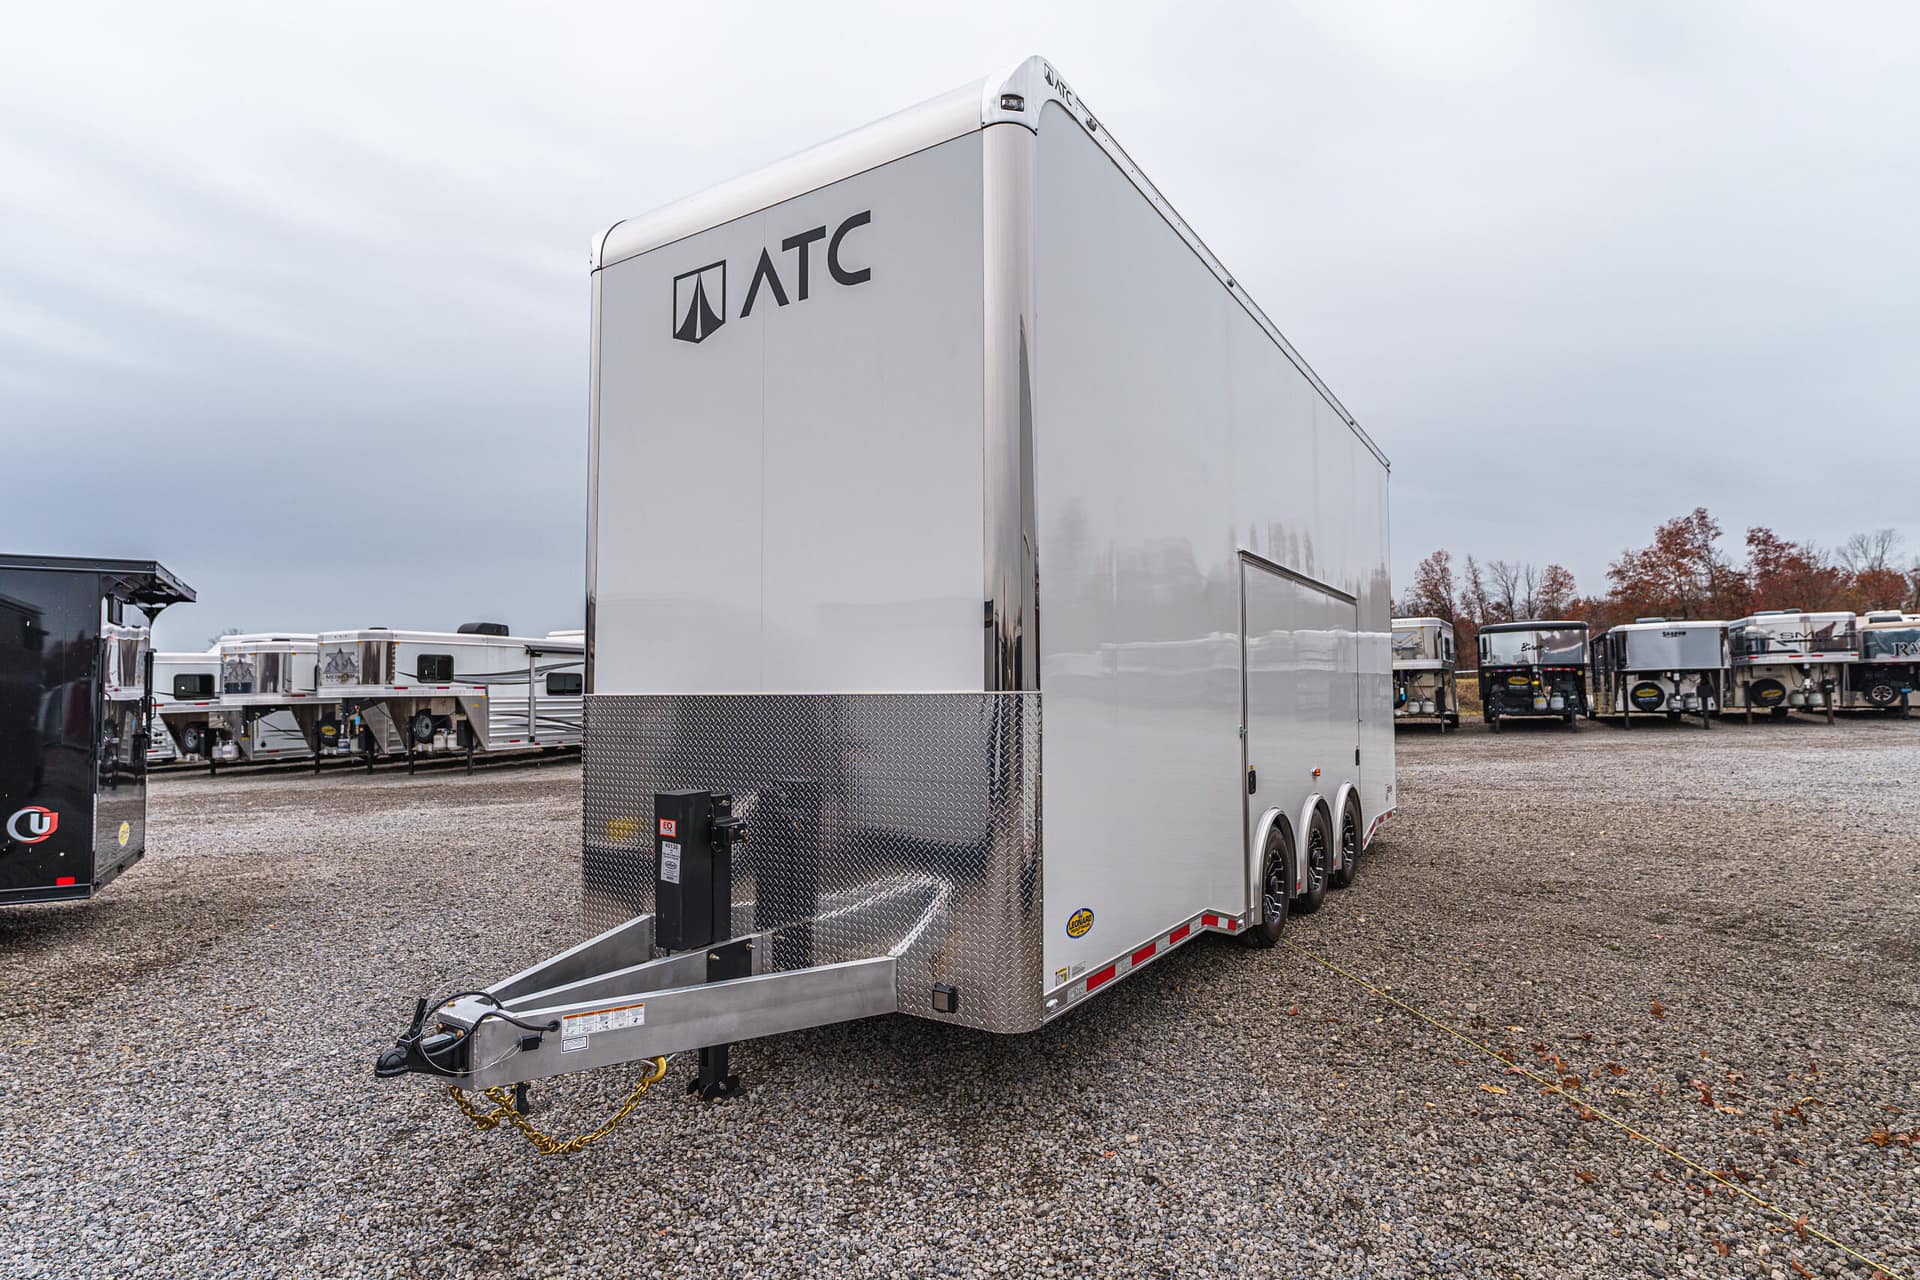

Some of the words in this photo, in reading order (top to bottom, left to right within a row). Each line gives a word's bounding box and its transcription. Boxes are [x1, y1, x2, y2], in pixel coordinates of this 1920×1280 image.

[1054, 79, 1073, 107] ATC
[739, 209, 872, 319] ATC
[663, 821, 673, 832] EQ
